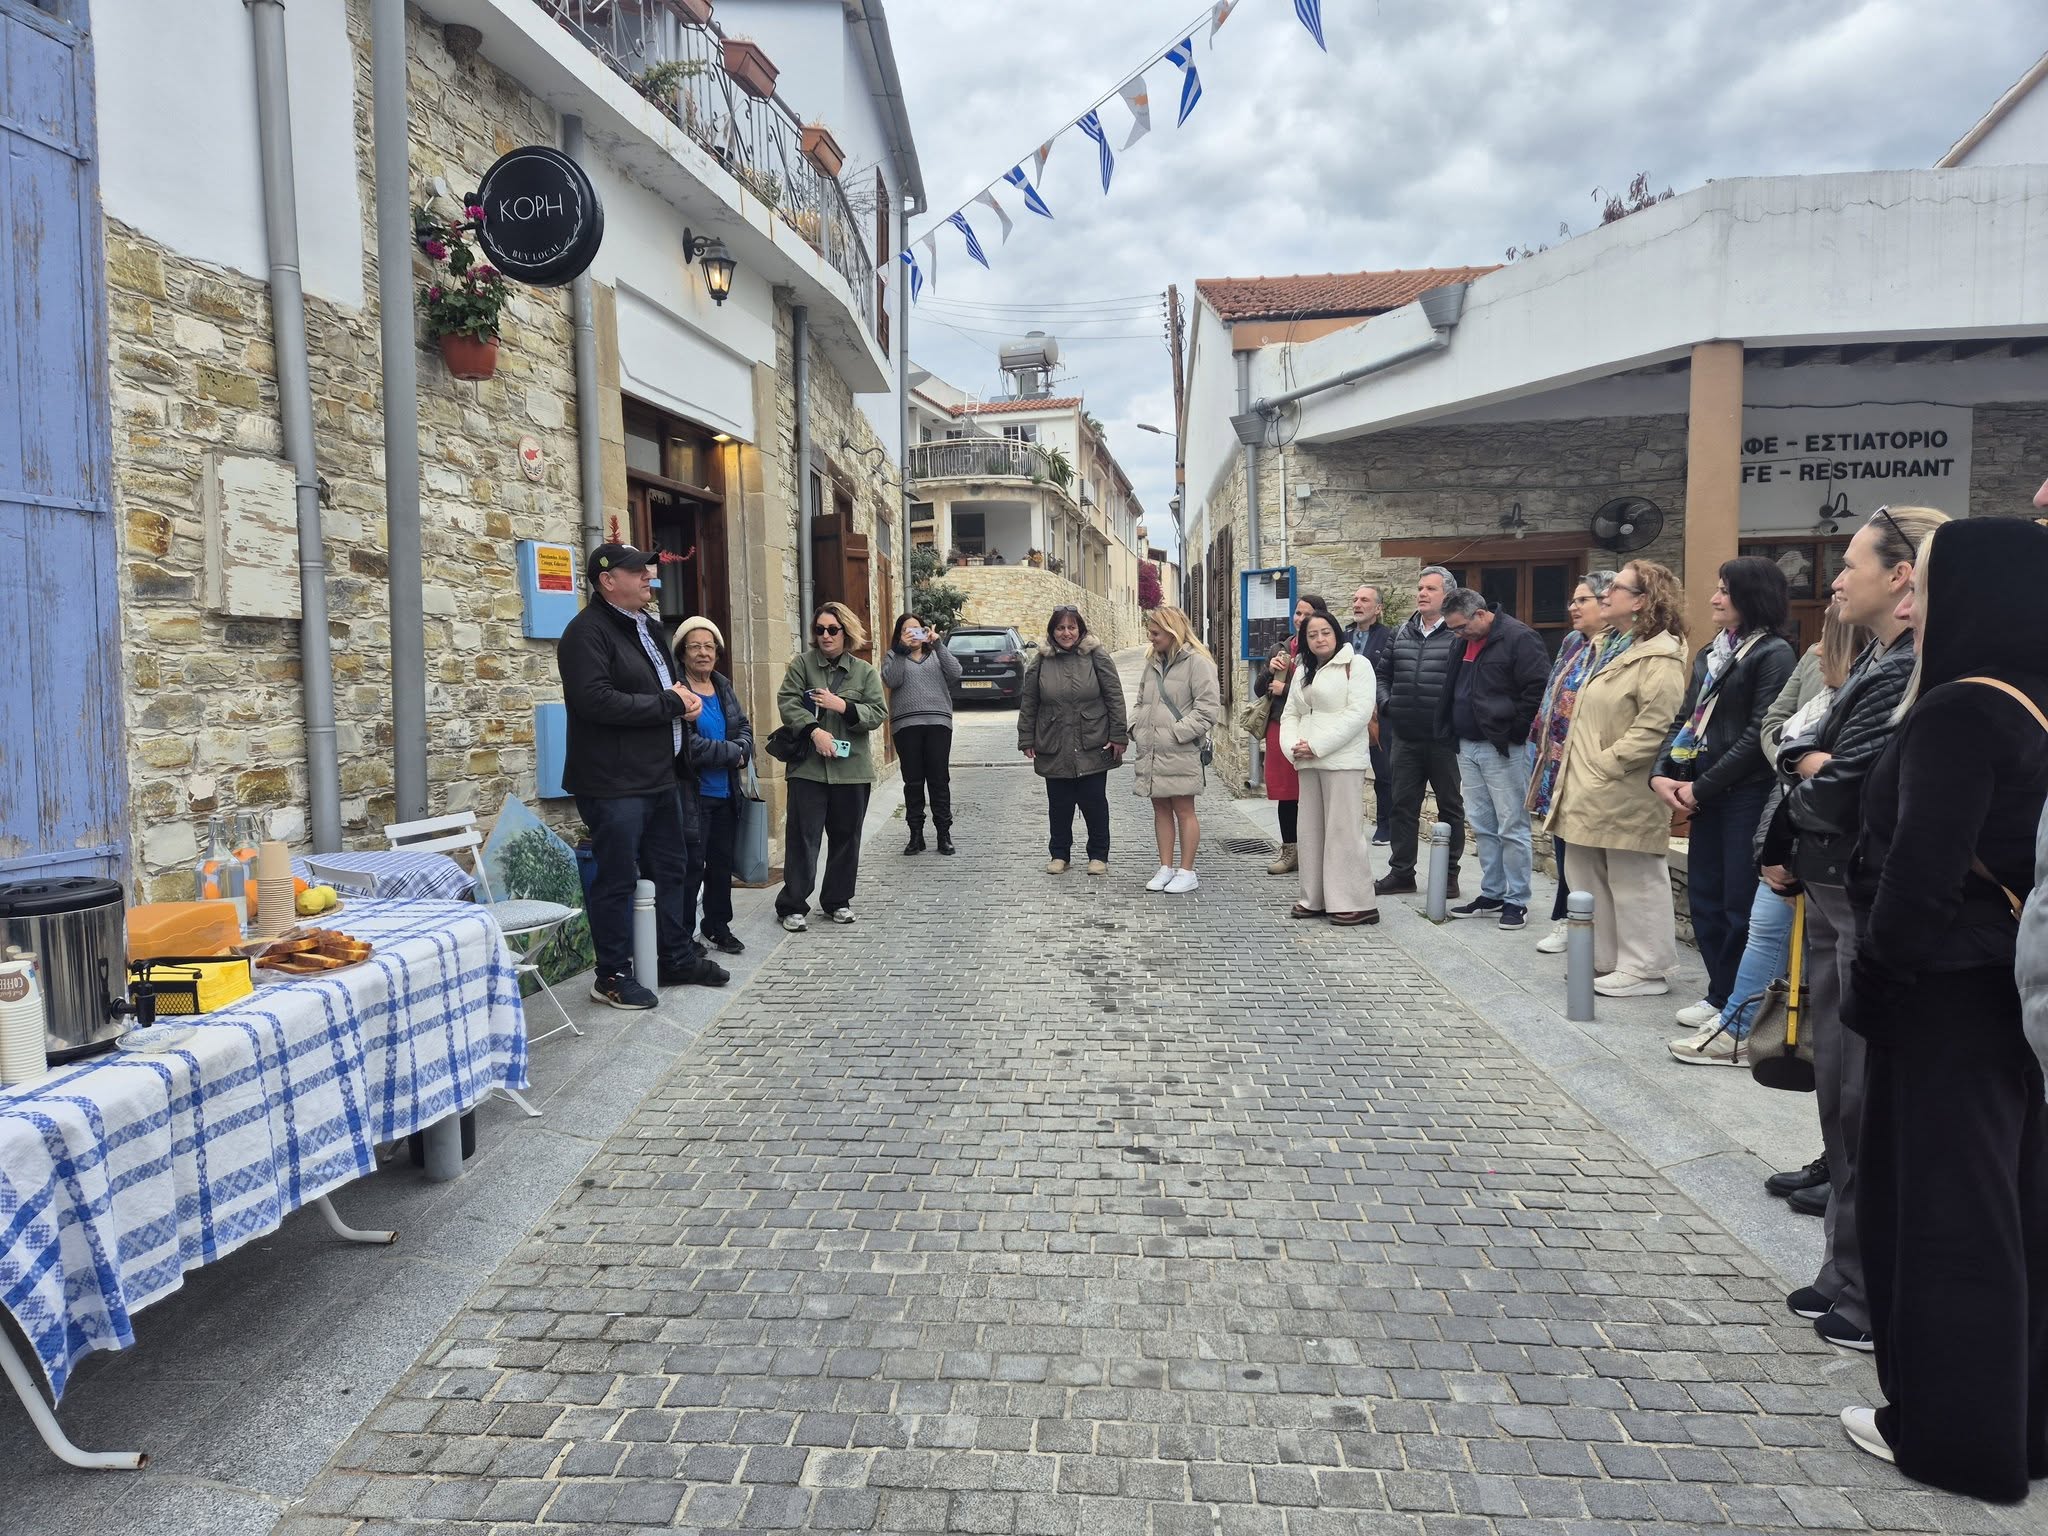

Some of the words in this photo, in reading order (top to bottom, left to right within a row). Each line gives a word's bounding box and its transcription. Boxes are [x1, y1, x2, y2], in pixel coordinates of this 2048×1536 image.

[511, 249, 529, 261] BUY
[532, 243, 562, 262] LOCAL
[1741, 436, 1778, 455] ΦΕ
[1805, 430, 1948, 453] ΕΣΤΙΑΤΟΡΙΟ
[1742, 465, 1772, 483] FE
[1799, 458, 1955, 481] RESTAURANT
